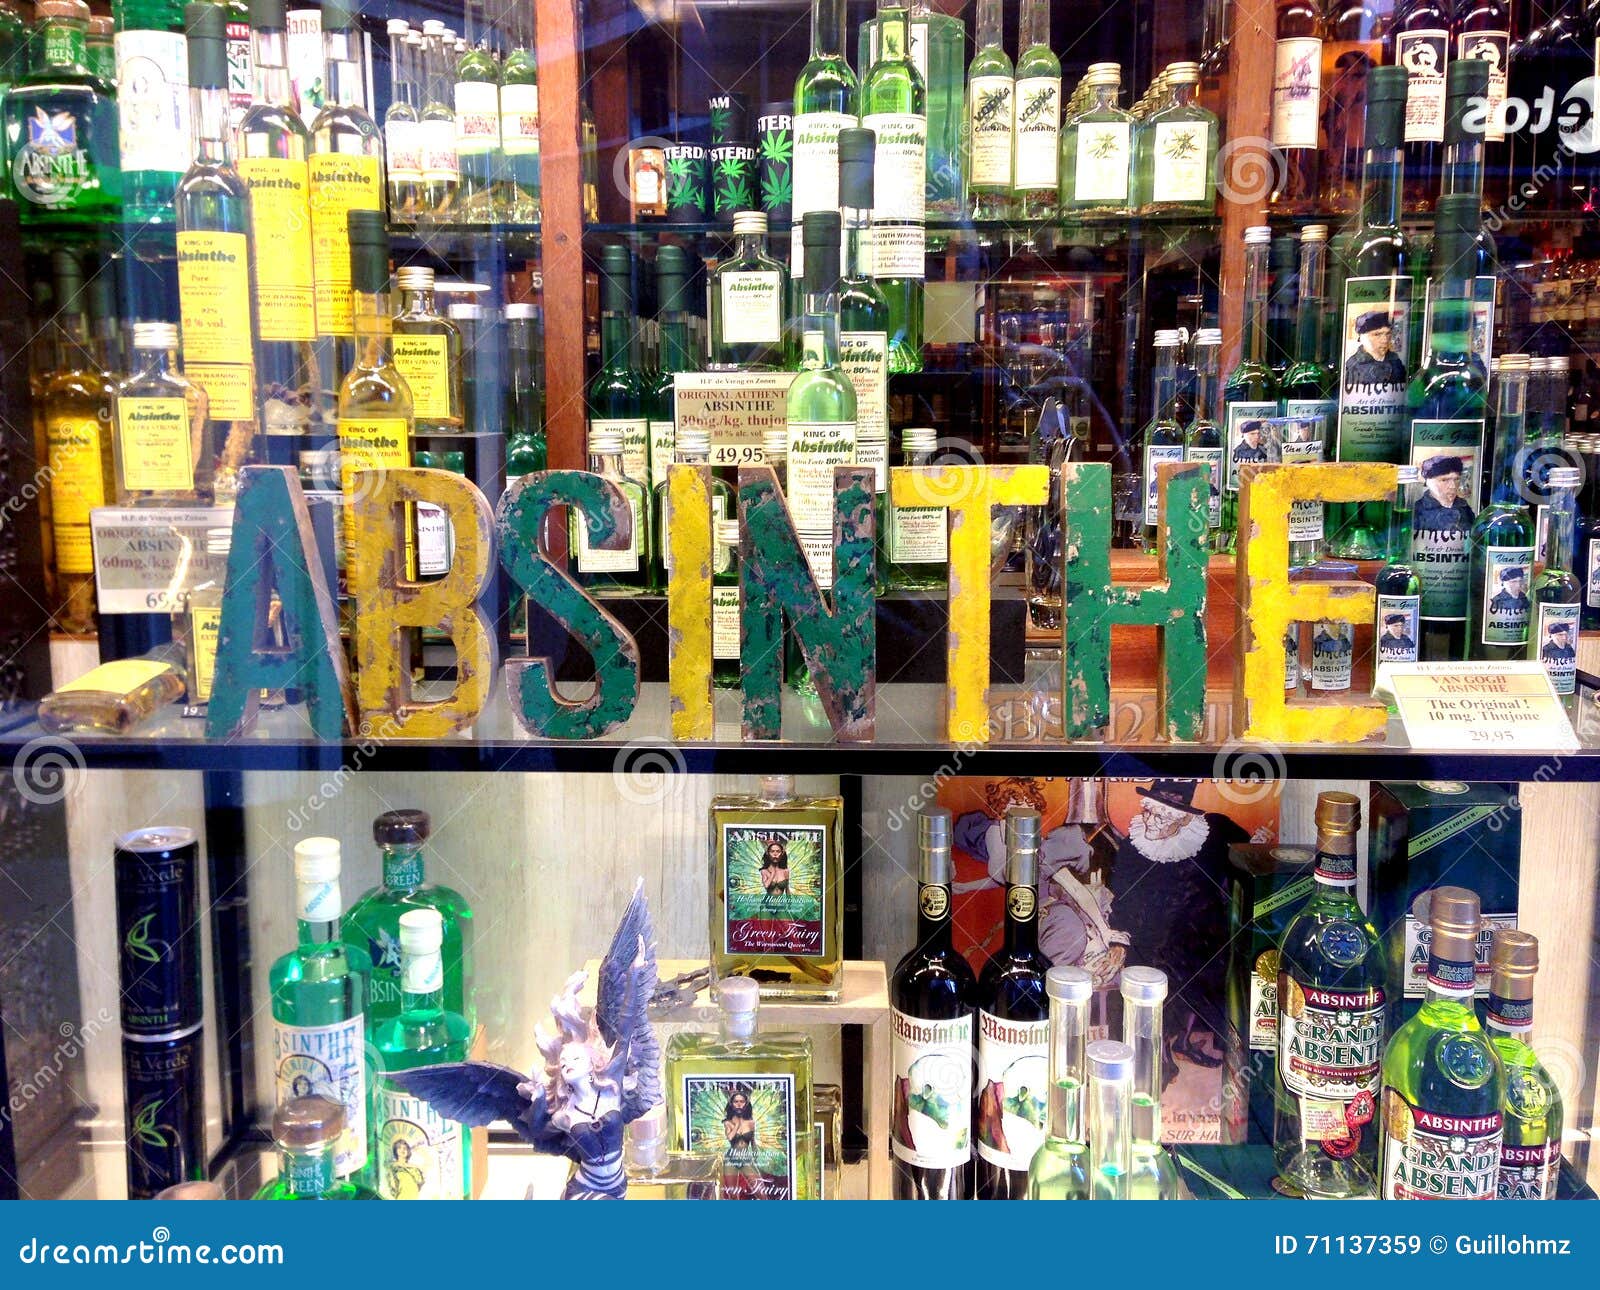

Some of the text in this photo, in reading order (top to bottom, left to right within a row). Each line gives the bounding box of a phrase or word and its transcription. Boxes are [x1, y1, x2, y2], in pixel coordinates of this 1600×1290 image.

[798, 133, 839, 145] Absin
[878, 133, 925, 146] bsinthe
[247, 177, 301, 191] bsinthe
[311, 171, 371, 186] Absinthe
[729, 282, 775, 292] Absinthe
[394, 347, 441, 357] Absinthe
[678, 391, 786, 399] ORIGINAL AUTHENT
[703, 400, 775, 411] ABSINTHE
[1341, 405, 1408, 415] ABSINTH
[127, 411, 182, 422] Absinthe
[802, 430, 841, 438] KING OF
[791, 439, 854, 453] Absinthe
[715, 447, 763, 464] 49,95
[826, 457, 844, 465] 80%
[1290, 515, 1322, 524] BSINTH
[1412, 552, 1470, 563] BSINTH
[1495, 554, 1514, 563] Van
[207, 461, 1399, 743] ABSINTHE
[1488, 621, 1529, 629] ABSINT
[1430, 675, 1507, 685] VAN GOGH
[1437, 684, 1509, 694] ABSINTHE
[1427, 699, 1456, 710] The
[1459, 699, 1521, 712] Original
[1428, 711, 1540, 724] 10 mg. Thujone
[386, 873, 420, 886] GREEN
[732, 921, 819, 945] Green Fairy
[1309, 990, 1381, 1007] ABSINTHE
[892, 1015, 970, 1046] Mansinthe
[980, 1017, 1049, 1046] Mansint
[273, 1025, 358, 1071] BSINTHE
[1419, 1114, 1498, 1132] ABSINTHE
[1165, 1130, 1194, 1141] SUR
[1393, 1161, 1498, 1197] ABSENT
[746, 1177, 789, 1200] Fairy
